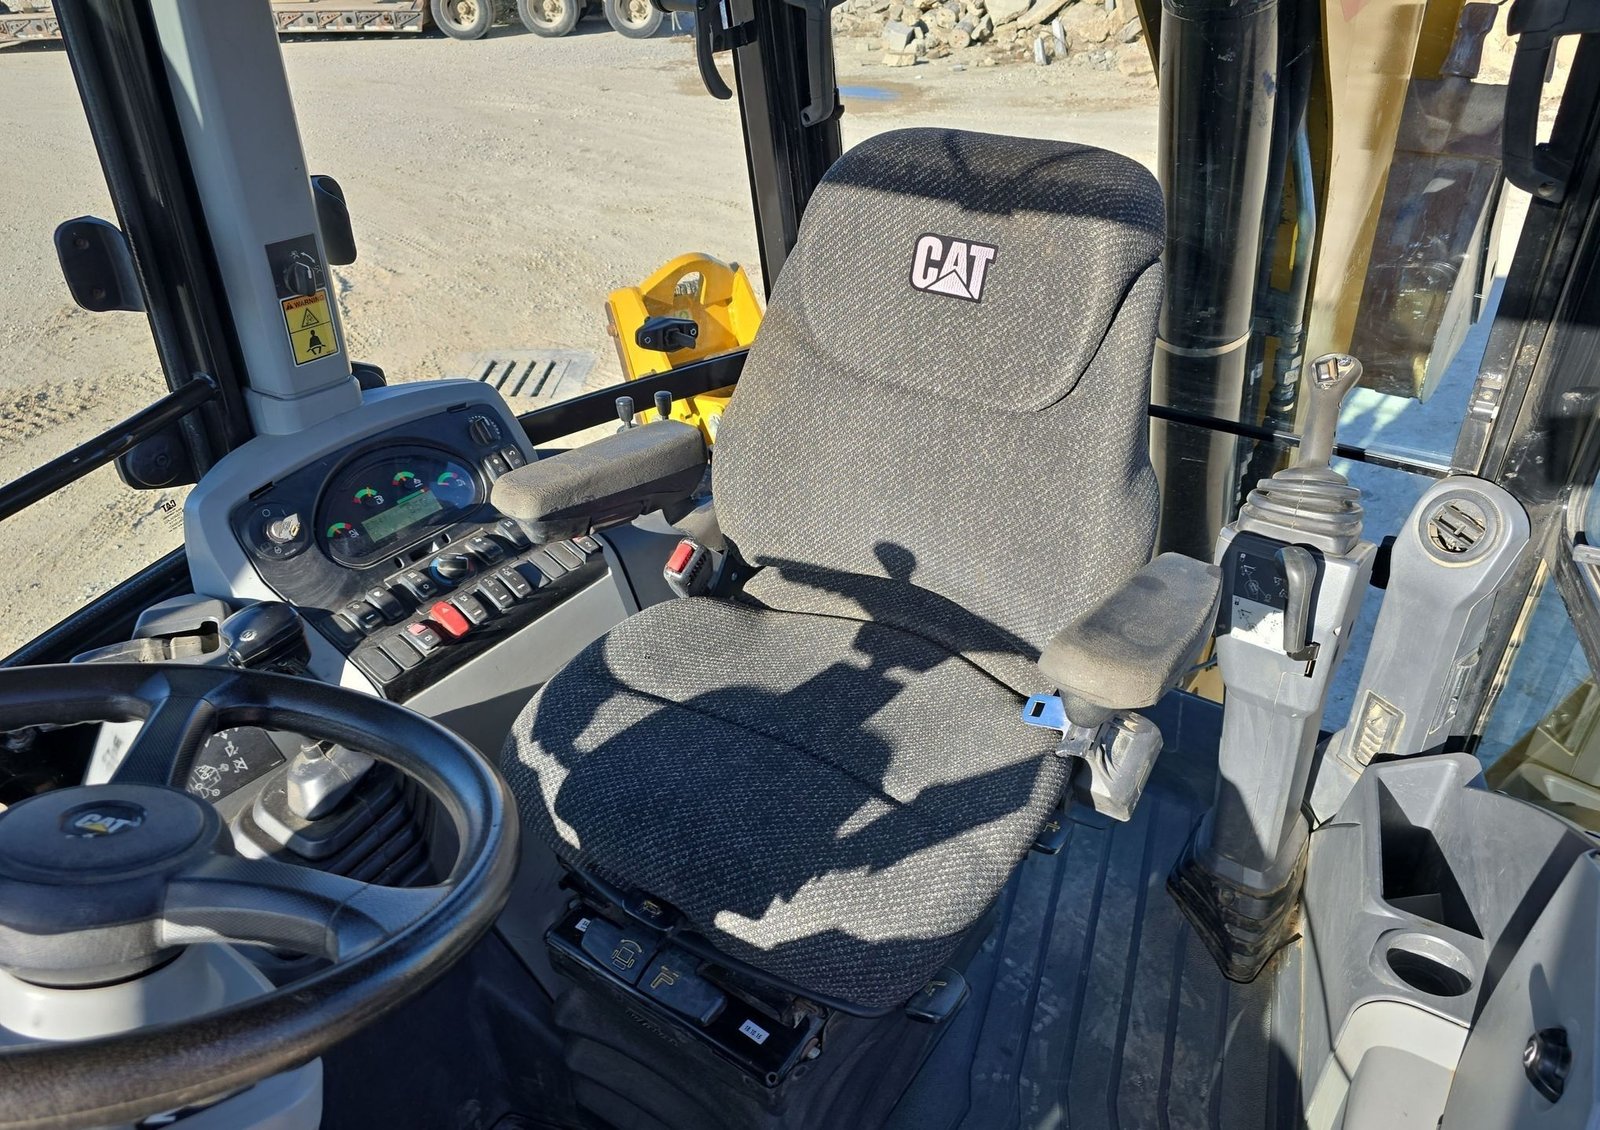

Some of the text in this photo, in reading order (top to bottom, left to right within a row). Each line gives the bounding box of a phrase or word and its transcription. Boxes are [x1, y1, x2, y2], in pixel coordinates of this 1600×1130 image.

[911, 235, 996, 301] CAT
[293, 294, 325, 309] WARNING
[74, 813, 132, 834] CAT
